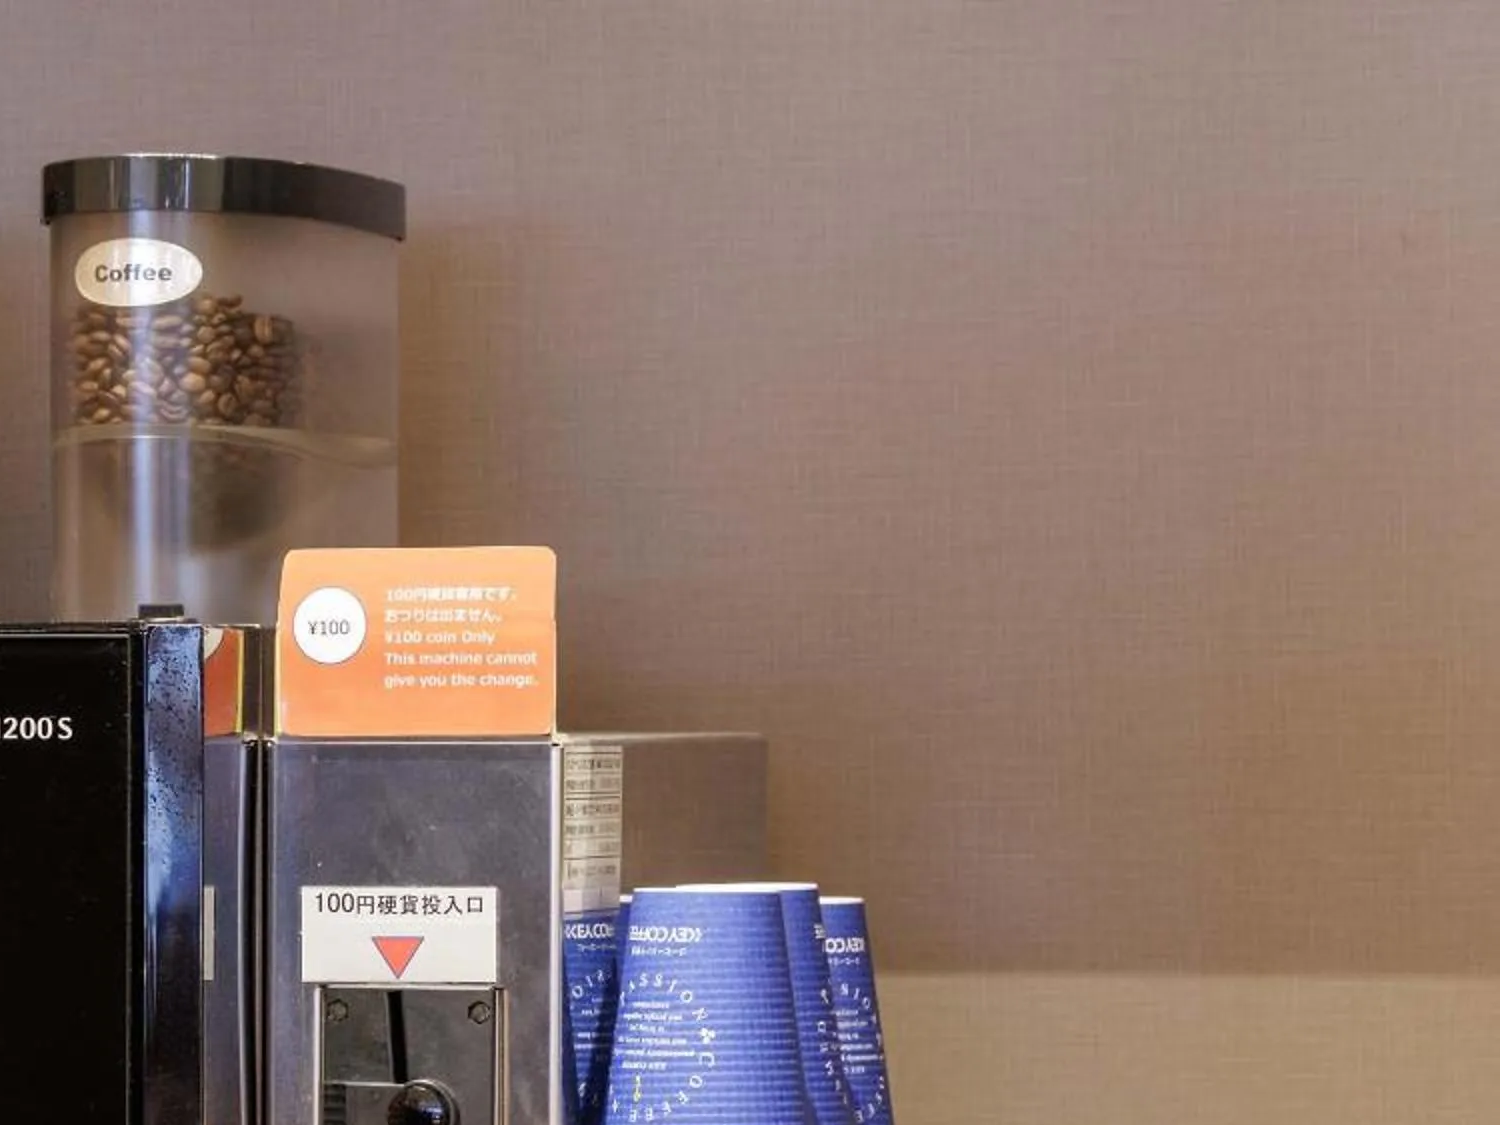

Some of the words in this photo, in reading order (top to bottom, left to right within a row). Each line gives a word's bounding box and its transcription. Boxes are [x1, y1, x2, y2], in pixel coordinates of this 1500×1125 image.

[95, 263, 172, 282] Coffee
[308, 620, 350, 636] ¥100
[426, 631, 457, 645] coin
[462, 631, 495, 646] Only
[385, 652, 415, 665] This
[419, 652, 483, 665] machine
[486, 652, 537, 666] cannot
[385, 675, 415, 689] give
[419, 676, 447, 689] you
[450, 673, 476, 687] the
[315, 892, 484, 915] 100円硬貨投入口
